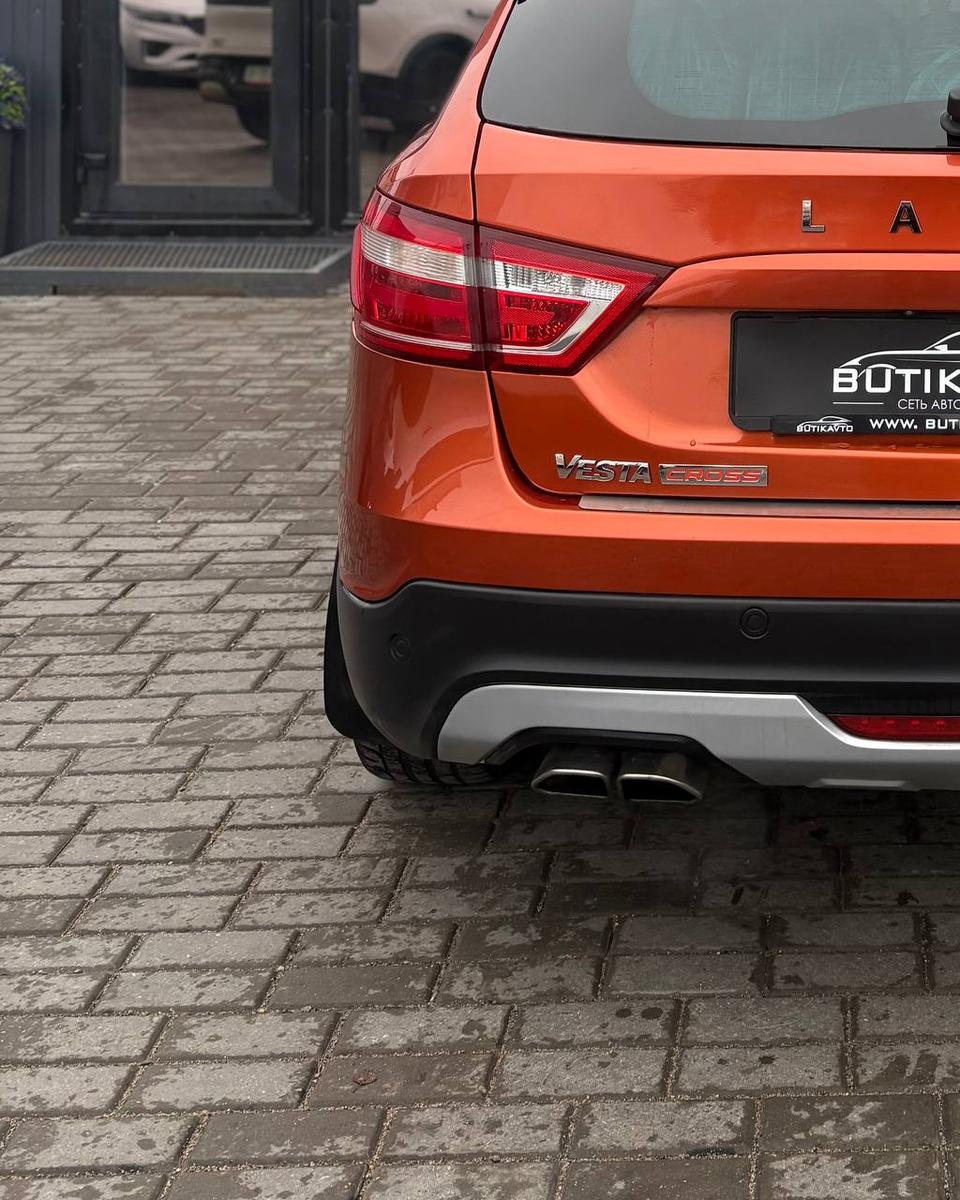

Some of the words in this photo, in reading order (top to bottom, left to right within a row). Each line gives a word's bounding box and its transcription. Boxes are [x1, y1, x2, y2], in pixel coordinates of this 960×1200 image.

[897, 398, 928, 410] СЕТЬ
[796, 423, 854, 433] BUTIKAVTO
[869, 418, 918, 430] WWW.
[555, 453, 652, 484] VESTA
[665, 469, 765, 484] CROSS
